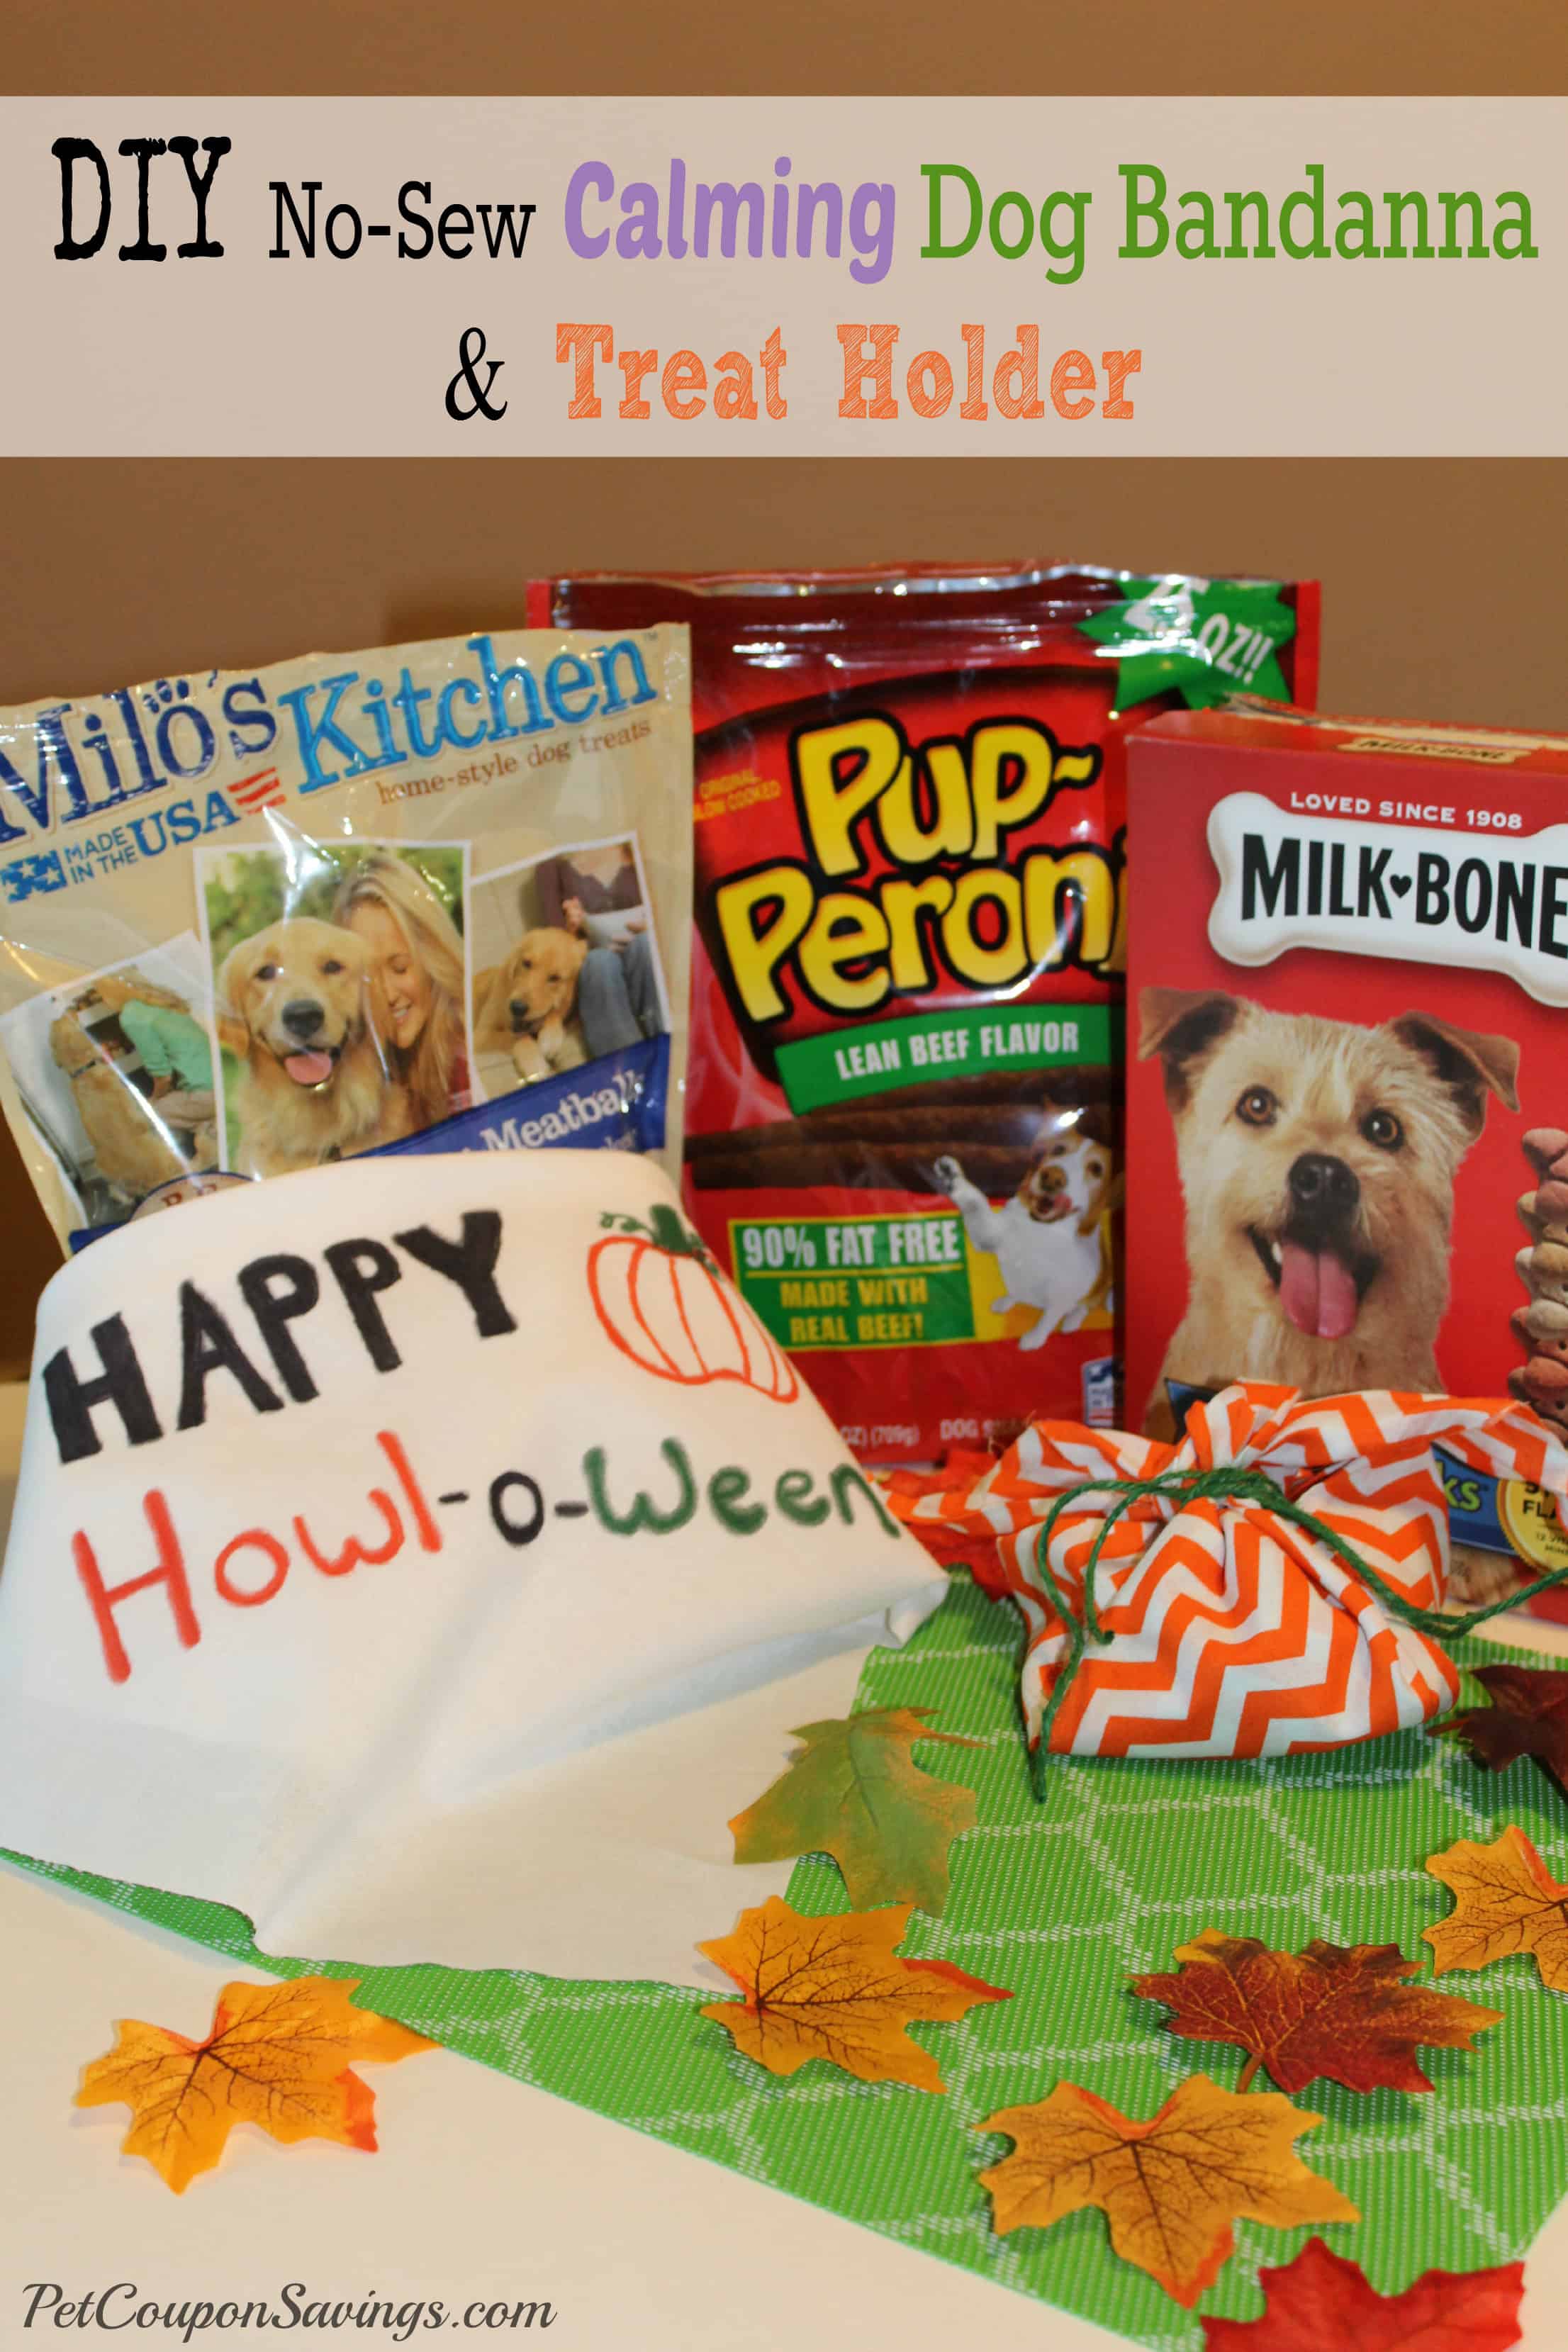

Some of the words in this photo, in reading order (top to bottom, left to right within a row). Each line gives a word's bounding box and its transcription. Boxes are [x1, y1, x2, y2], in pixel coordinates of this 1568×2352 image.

[279, 635, 657, 793] Kitchen
[376, 752, 517, 805] home-style
[527, 740, 572, 768] dog
[579, 718, 653, 754] treats
[126, 790, 241, 858] USA
[1291, 791, 1371, 816] LOVED
[1379, 800, 1456, 824] SINCE
[1466, 809, 1523, 829] 1908
[63, 827, 128, 863] MADE
[69, 861, 95, 884] IN
[96, 846, 139, 875] THE
[715, 851, 1126, 1023] Peron
[835, 1038, 901, 1081] LEAN
[907, 1028, 970, 1067] BEEF
[980, 1022, 1080, 1058] FLAVOR
[742, 1226, 817, 1268] 90%
[827, 1226, 875, 1265] FAT
[889, 1220, 961, 1262] FREE
[781, 1279, 850, 1308] MADE
[858, 1277, 928, 1306] WITH
[43, 1209, 518, 1465] HAPPY
[790, 1316, 849, 1343] REAL
[857, 1313, 924, 1341] BEEF!
[940, 1418, 979, 1440] DOG
